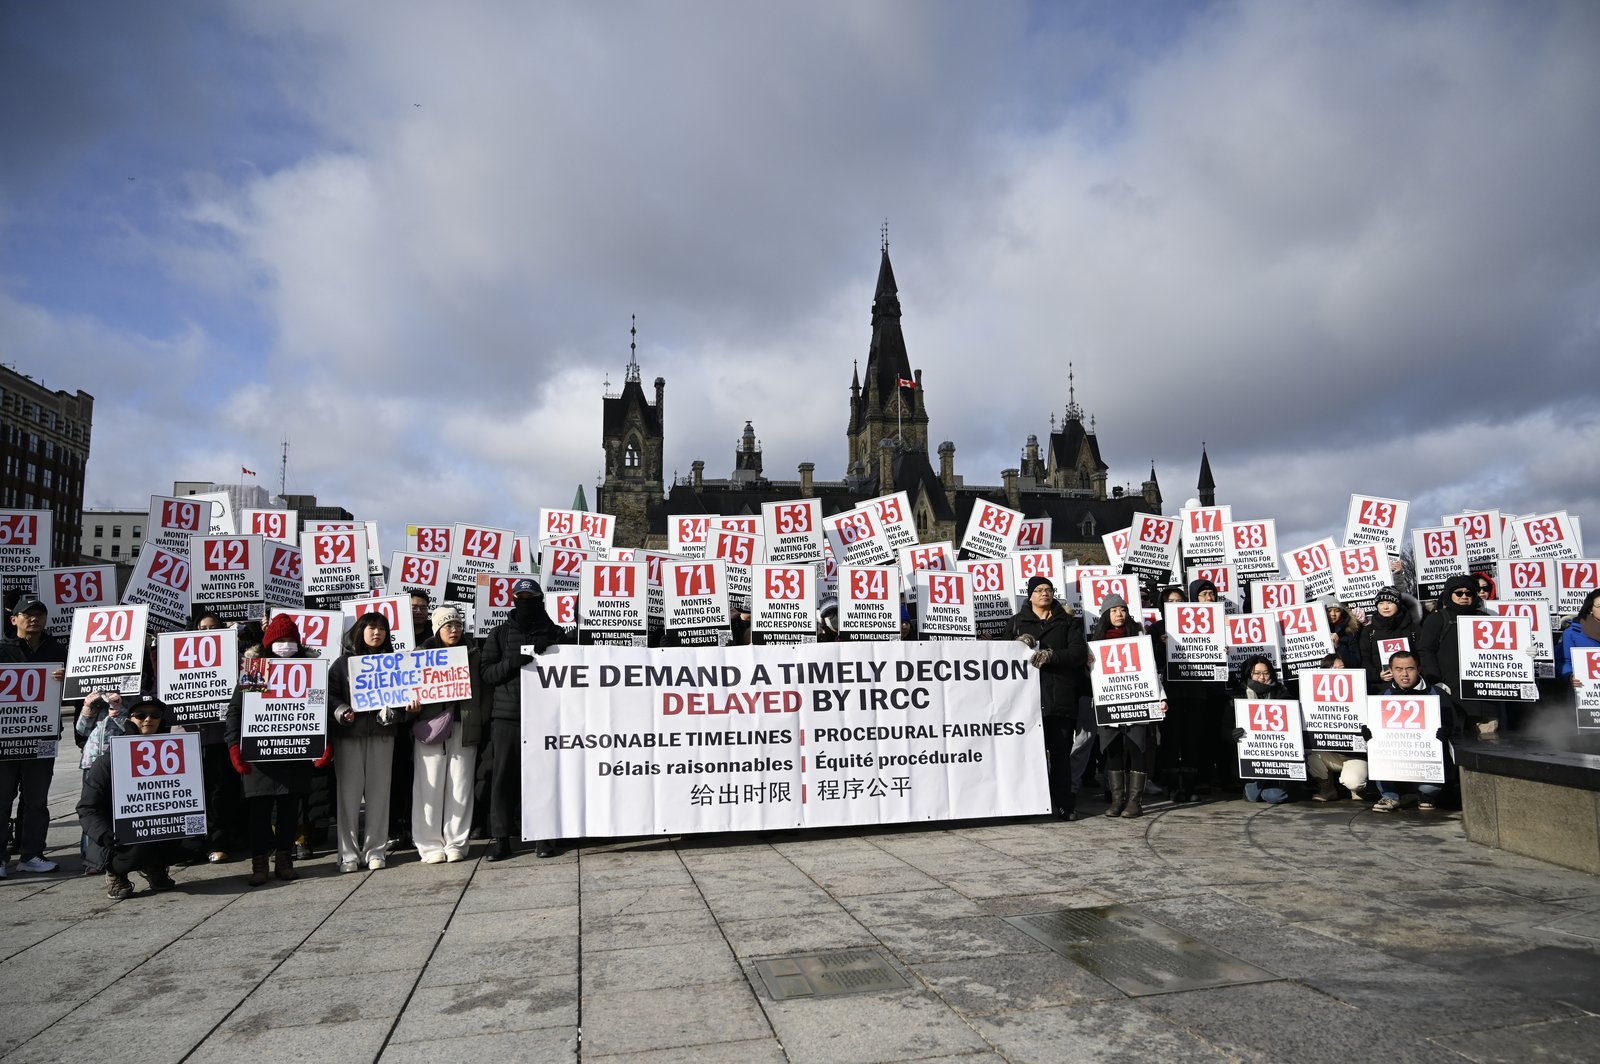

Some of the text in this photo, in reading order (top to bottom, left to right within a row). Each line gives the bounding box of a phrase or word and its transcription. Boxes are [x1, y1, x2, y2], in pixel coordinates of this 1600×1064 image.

[167, 502, 194, 529] 19
[551, 513, 570, 532] 25
[780, 505, 808, 532] 53
[983, 508, 1009, 534] 33
[1196, 511, 1216, 532] 17
[1364, 501, 1391, 526] 43
[257, 514, 282, 538] 19
[682, 520, 707, 542] 34
[841, 514, 870, 542] 68
[979, 531, 1003, 543] MONTHS
[1021, 524, 1040, 546] 27
[1144, 520, 1170, 543] 33
[1237, 525, 1263, 548] 38
[1530, 520, 1559, 544] 63
[319, 536, 351, 563] 32
[421, 529, 447, 552] 35
[467, 530, 496, 558] 42
[721, 536, 749, 563] 15
[780, 536, 809, 544] MONTHS
[966, 542, 979, 551] IRCC
[971, 536, 995, 547] WAITING
[1429, 533, 1454, 556] 65
[210, 541, 244, 569] 42
[786, 551, 821, 560] RESPONSE
[1024, 555, 1049, 578] 34
[1301, 547, 1329, 573] 30
[1346, 549, 1374, 573] 55
[152, 555, 188, 588] 20
[406, 558, 434, 584] 39
[600, 567, 628, 596] 11
[680, 566, 710, 595] 71
[973, 564, 999, 591] 68
[1515, 564, 1541, 587] 62
[1566, 564, 1593, 587] 72
[60, 572, 97, 603] 36
[770, 570, 800, 598] 53
[855, 571, 884, 599] 34
[935, 577, 960, 603] 51
[1267, 585, 1292, 608] 30
[674, 607, 705, 616] WAITING
[687, 616, 725, 624] RESPONSE
[1182, 608, 1211, 633] 33
[1283, 608, 1312, 634] 24
[91, 612, 127, 641] 20
[1234, 618, 1262, 643] 46
[1478, 622, 1512, 648] 34
[179, 637, 216, 667] 40
[361, 650, 448, 673] STOP THE
[1106, 646, 1136, 672] 41
[0, 670, 40, 701] 20
[268, 665, 306, 697] 40
[537, 660, 1029, 688] WE DEMAND A TIMELY DECISION
[1109, 675, 1139, 683] MONTHS
[1102, 683, 1132, 692] WAITING
[1116, 691, 1154, 700] RESPONSE
[1317, 675, 1348, 701] 40
[663, 687, 930, 715] DELAYED BY IRCC
[255, 713, 294, 722] WAITING
[1254, 705, 1284, 730] 43
[1386, 701, 1420, 728] 22
[271, 723, 320, 731] RESPONSE
[814, 722, 1026, 742] PROCEDURAL FAIRNESS
[544, 730, 792, 750] REASONABLE TIMELINES
[137, 740, 179, 776] 36
[599, 757, 793, 776] Délais raisonnables
[816, 749, 982, 771] Équité procédurale
[127, 789, 192, 802] WAITING FOR
[138, 779, 180, 790] MONTHS
[690, 781, 792, 806] 给出时限
[818, 776, 912, 801] 程序公平
[121, 799, 198, 814] IRCC RESPONSE
[151, 825, 186, 834] RESULTS
